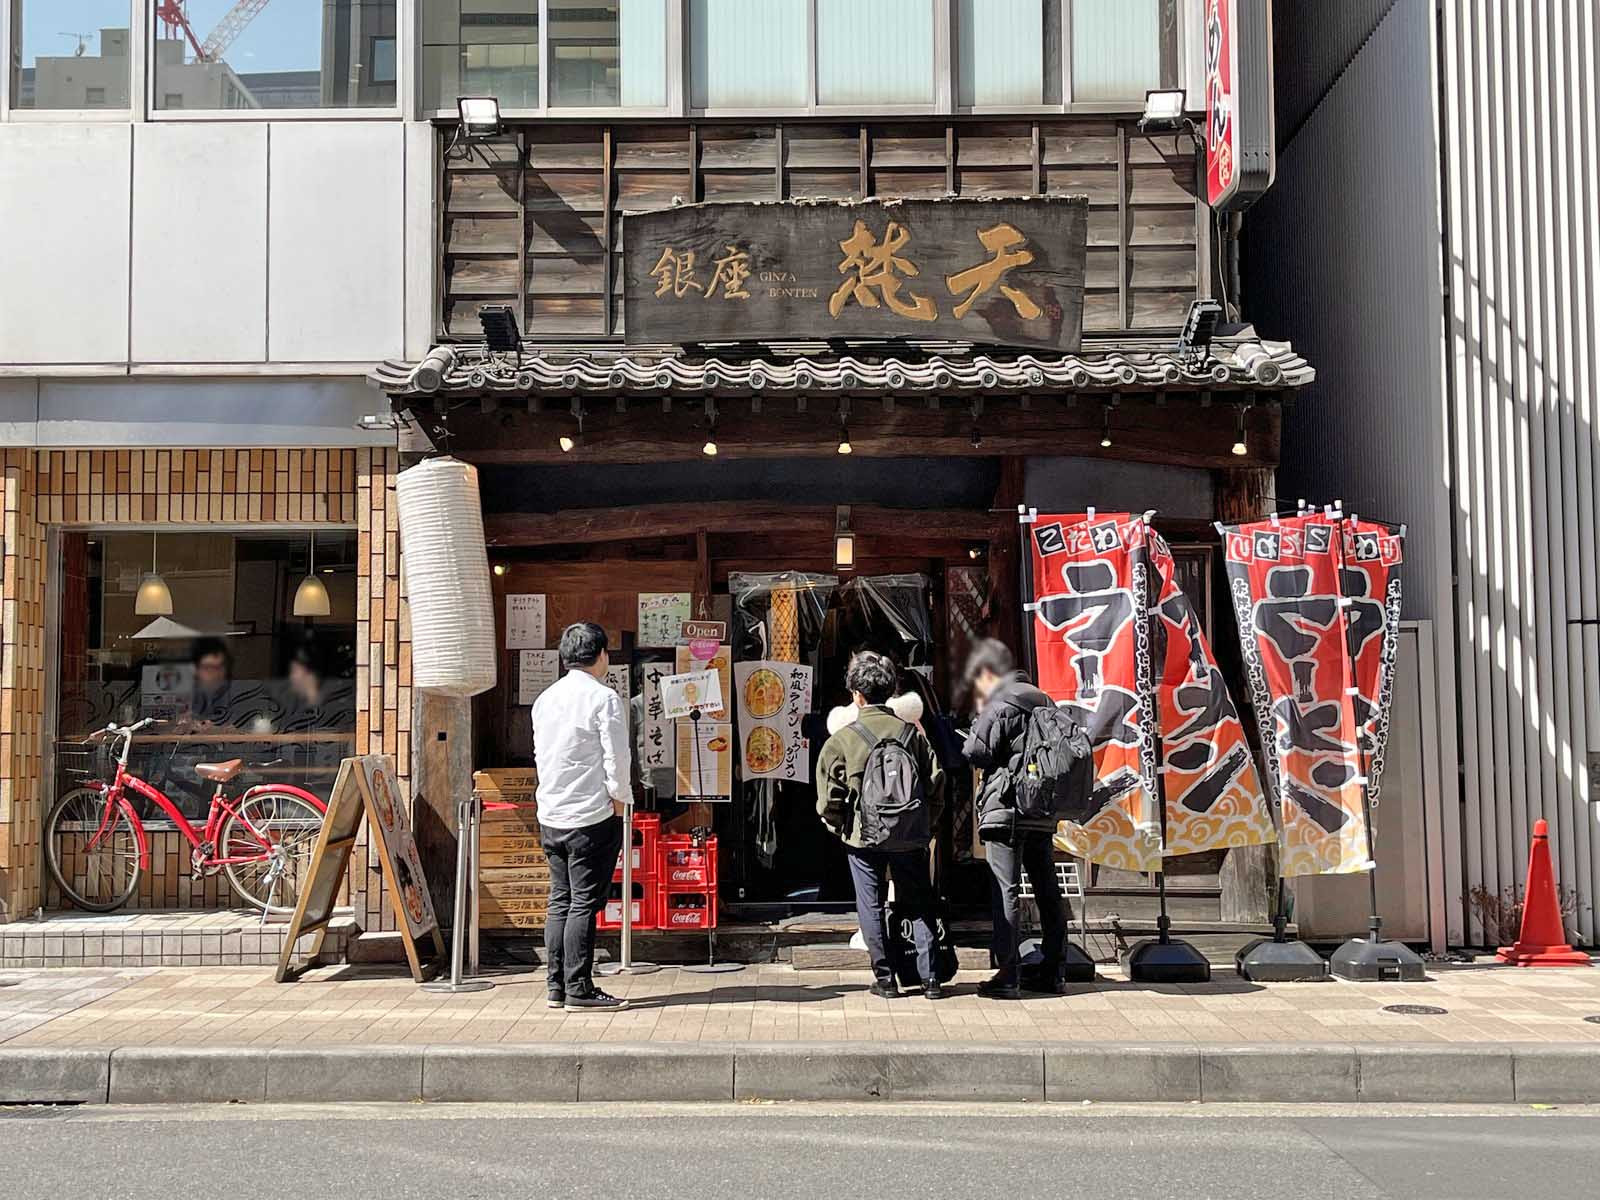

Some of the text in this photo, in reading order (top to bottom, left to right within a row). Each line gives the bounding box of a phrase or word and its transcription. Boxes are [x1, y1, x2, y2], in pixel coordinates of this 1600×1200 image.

[649, 244, 751, 300] 銀座
[759, 271, 797, 283] GINZA
[828, 219, 1044, 321] 梵天
[769, 286, 818, 298] BONTEN
[1038, 521, 1144, 555] こだわり
[686, 623, 718, 638] Open
[787, 667, 804, 727] 和風ラーメン
[646, 668, 665, 765] 中華そば
[672, 869, 703, 881] Coca-Cola
[671, 911, 702, 923] Coca-Cola
